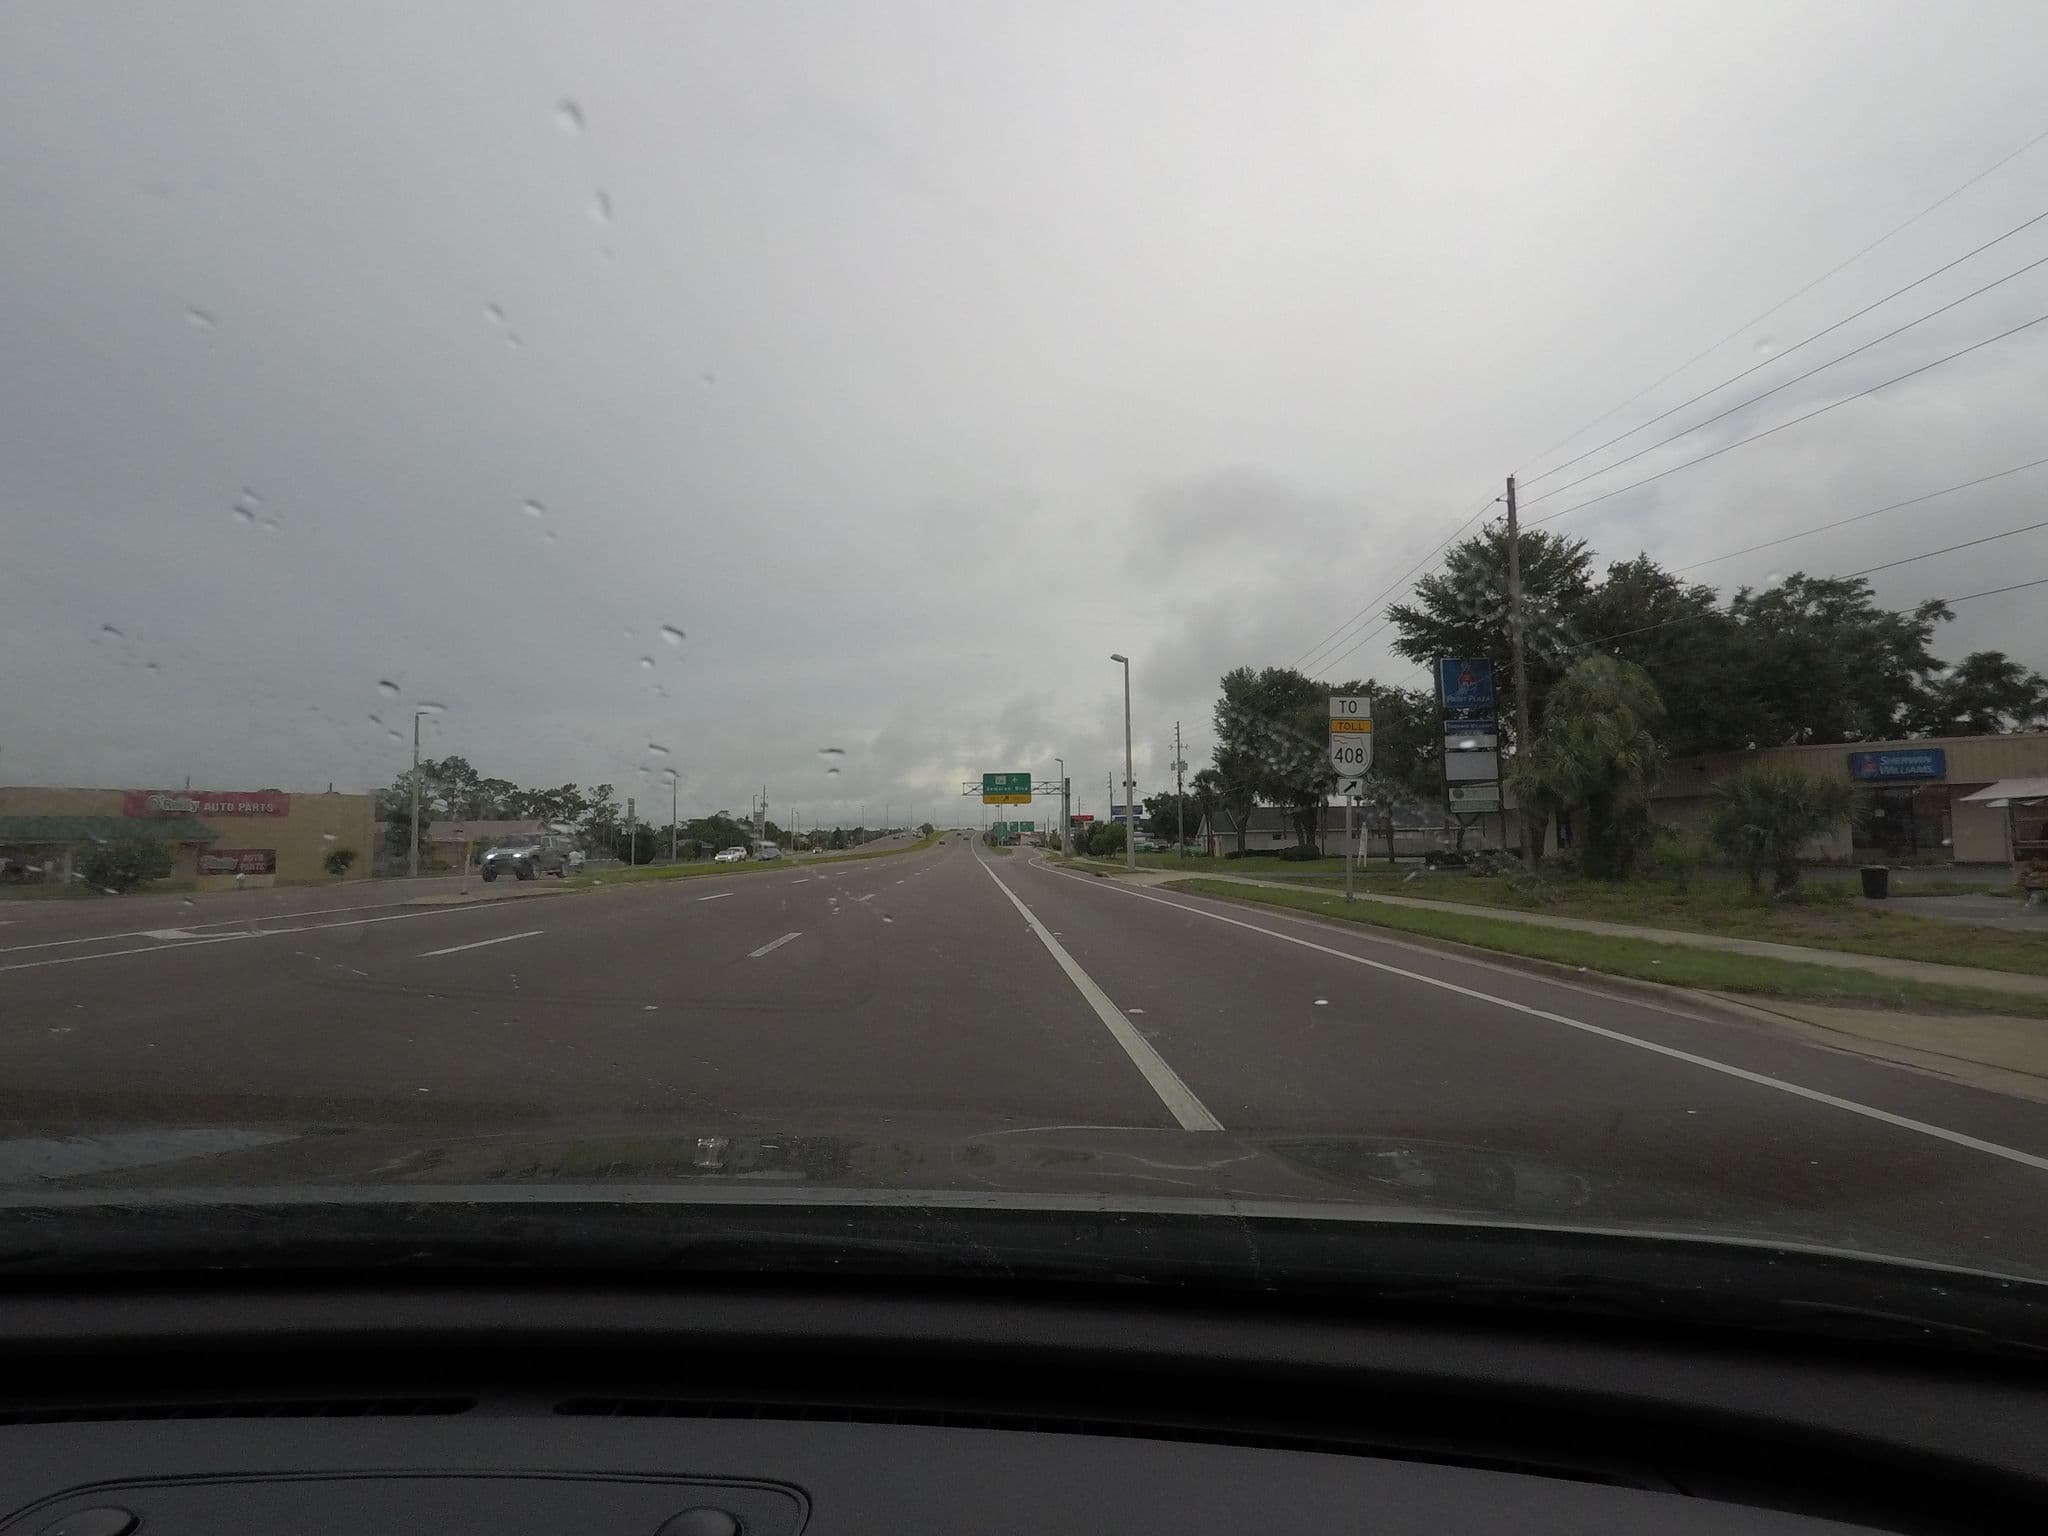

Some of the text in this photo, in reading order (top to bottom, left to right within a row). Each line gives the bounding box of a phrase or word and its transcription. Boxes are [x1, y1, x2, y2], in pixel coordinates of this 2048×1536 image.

[1338, 700, 1358, 714] TO
[1339, 722, 1364, 731] TOLL
[1334, 747, 1364, 764] 408
[204, 801, 234, 813] AUTO
[238, 801, 275, 813] PARTS
